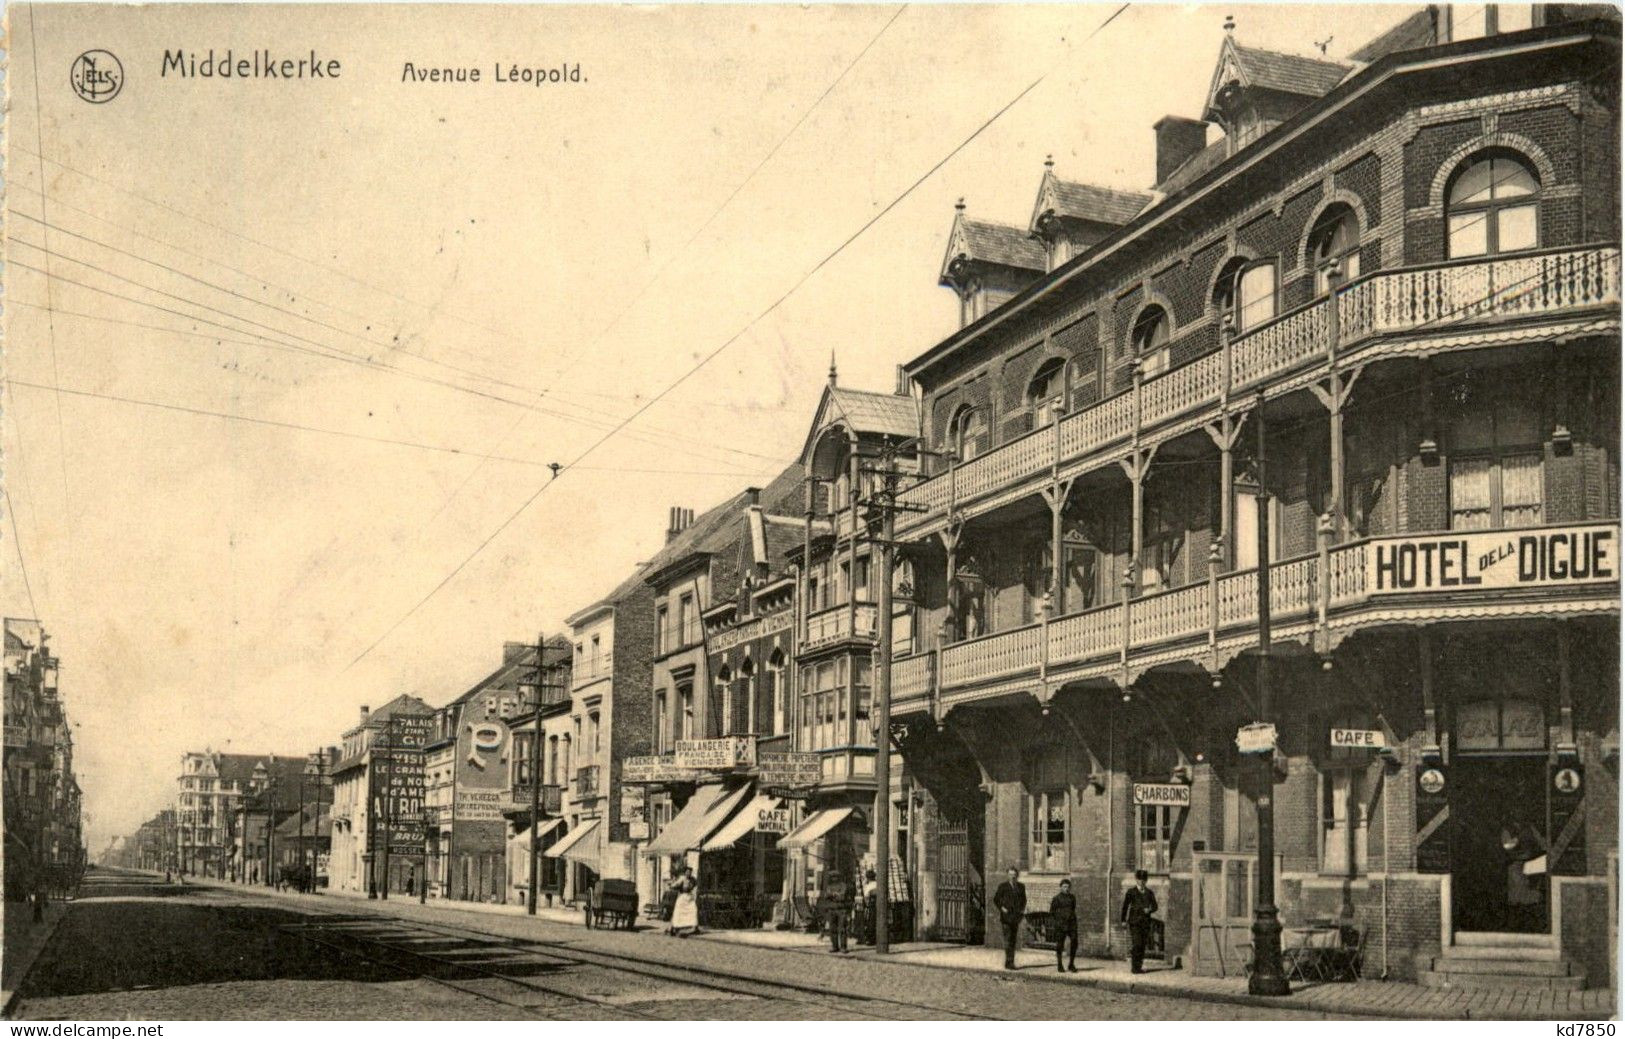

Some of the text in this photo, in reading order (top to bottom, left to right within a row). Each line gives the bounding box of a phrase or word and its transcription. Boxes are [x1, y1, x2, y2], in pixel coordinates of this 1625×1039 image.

[1479, 552, 1497, 571] DE
[1499, 541, 1515, 561] LA
[1518, 530, 1612, 582] DIGUE
[1335, 730, 1375, 744] CAFE
[676, 740, 731, 751] BOULANGERIE
[1134, 784, 1190, 802] CHARBONS
